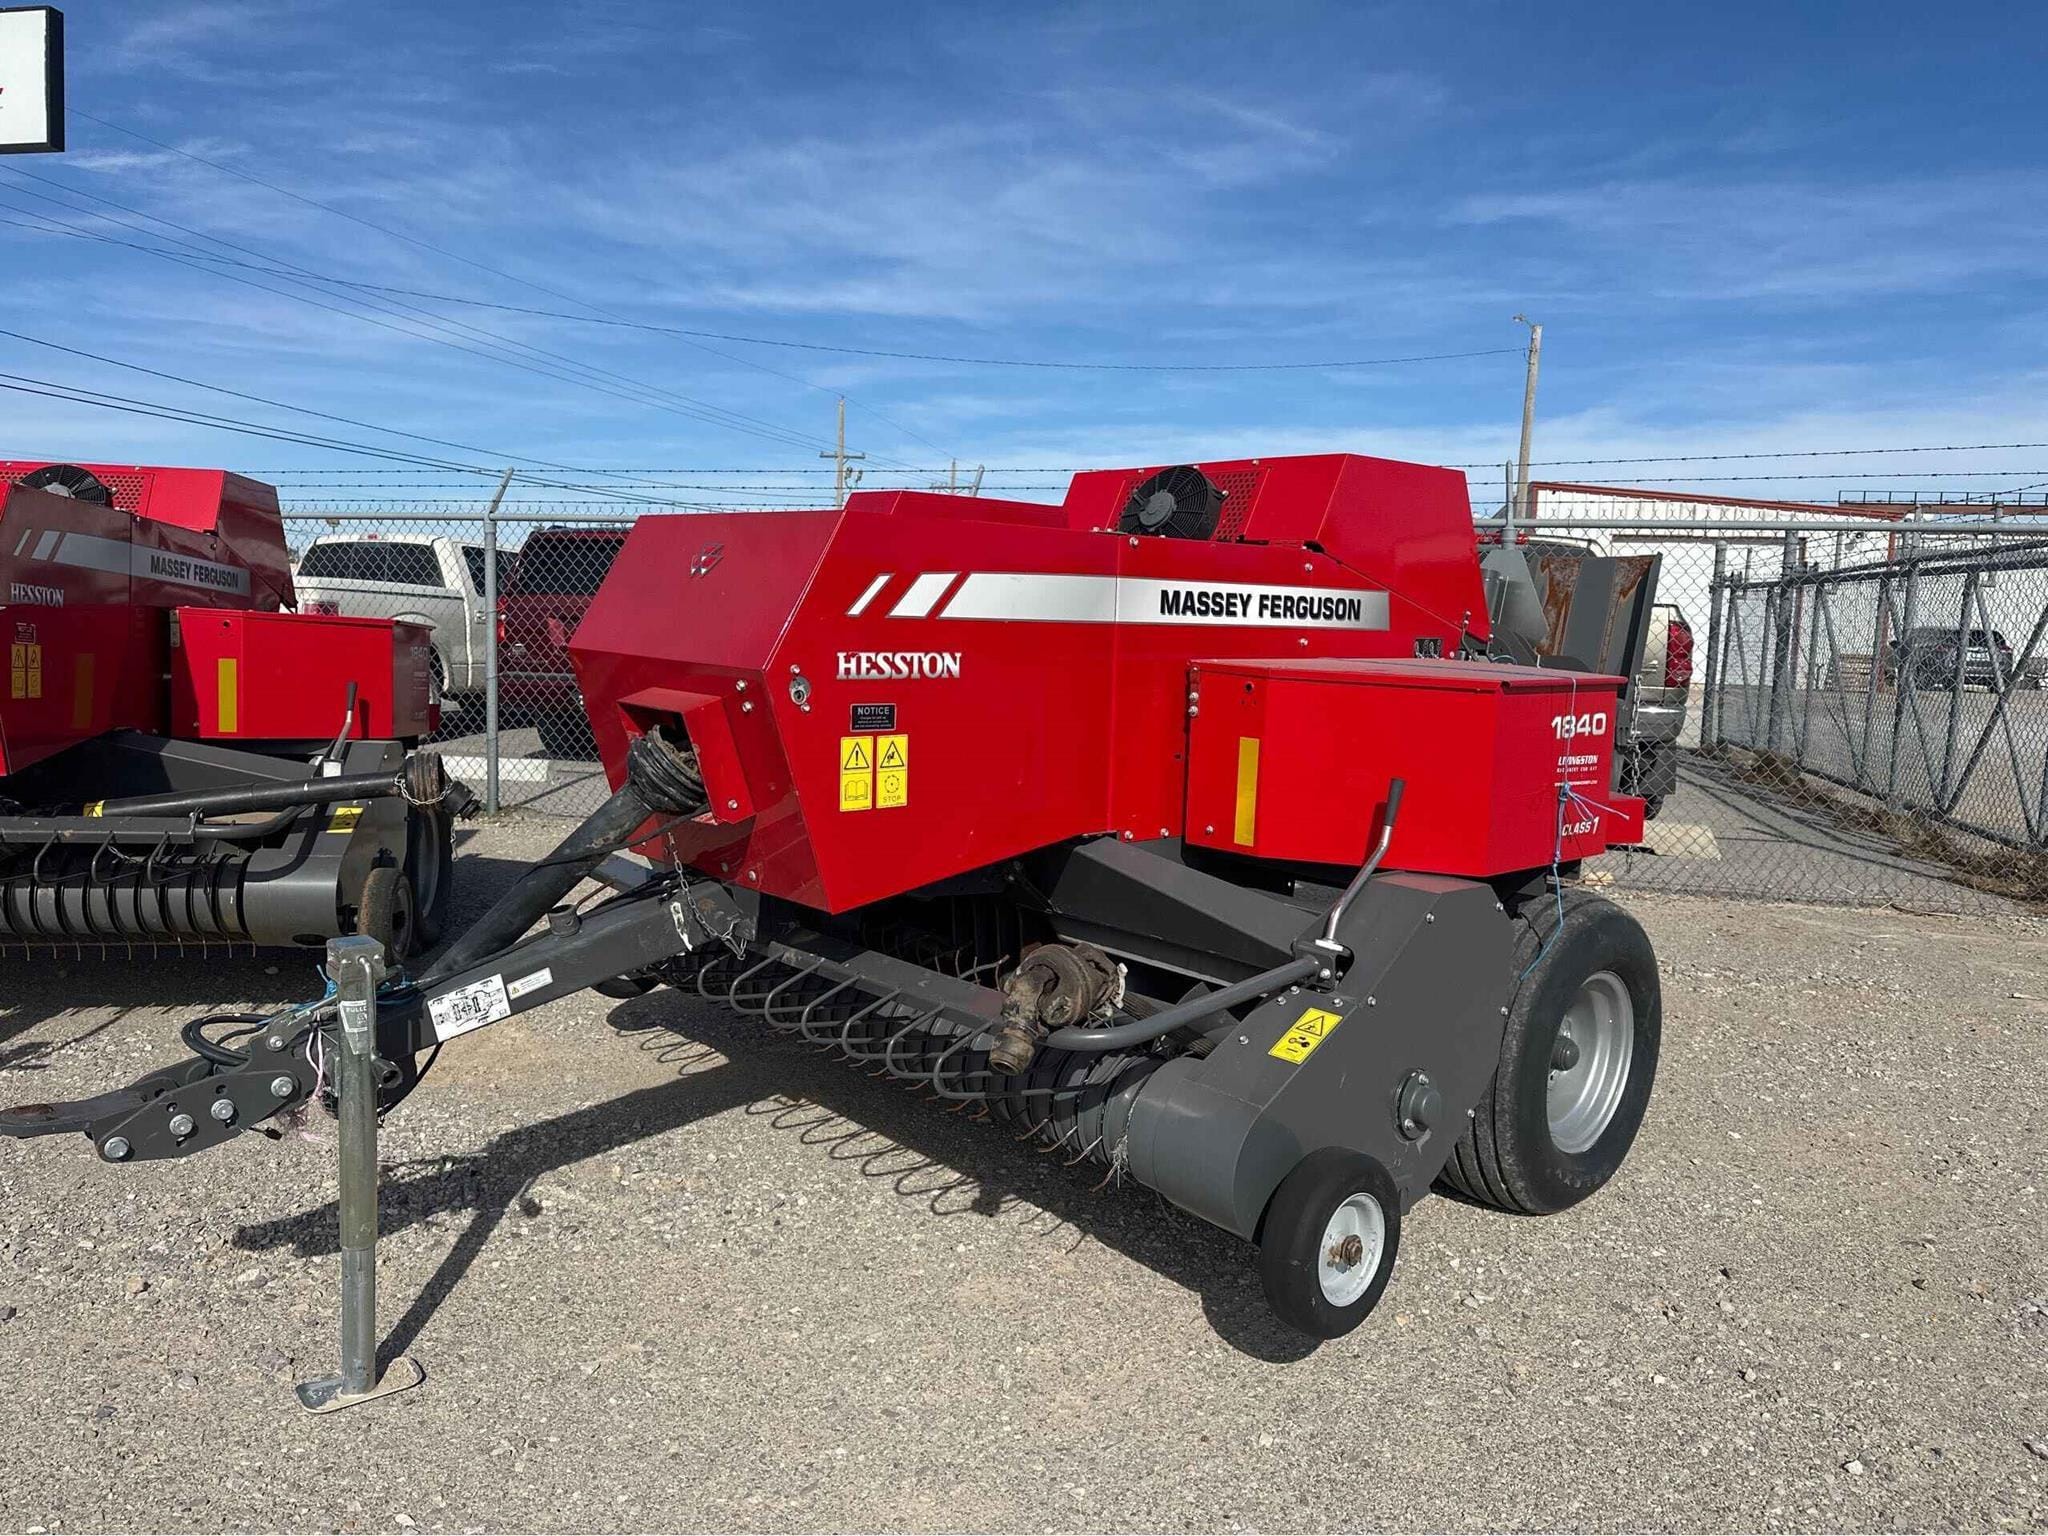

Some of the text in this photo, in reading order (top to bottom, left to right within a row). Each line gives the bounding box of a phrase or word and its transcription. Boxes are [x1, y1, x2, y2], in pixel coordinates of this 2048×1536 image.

[150, 555, 239, 588] MASSEY FERGUSON
[10, 582, 64, 608] HESSTON
[1160, 589, 1361, 621] MASSEY FERGUSON
[836, 651, 962, 680] HESSTON
[857, 706, 890, 715] NOTICE
[1551, 713, 1606, 739] 1840
